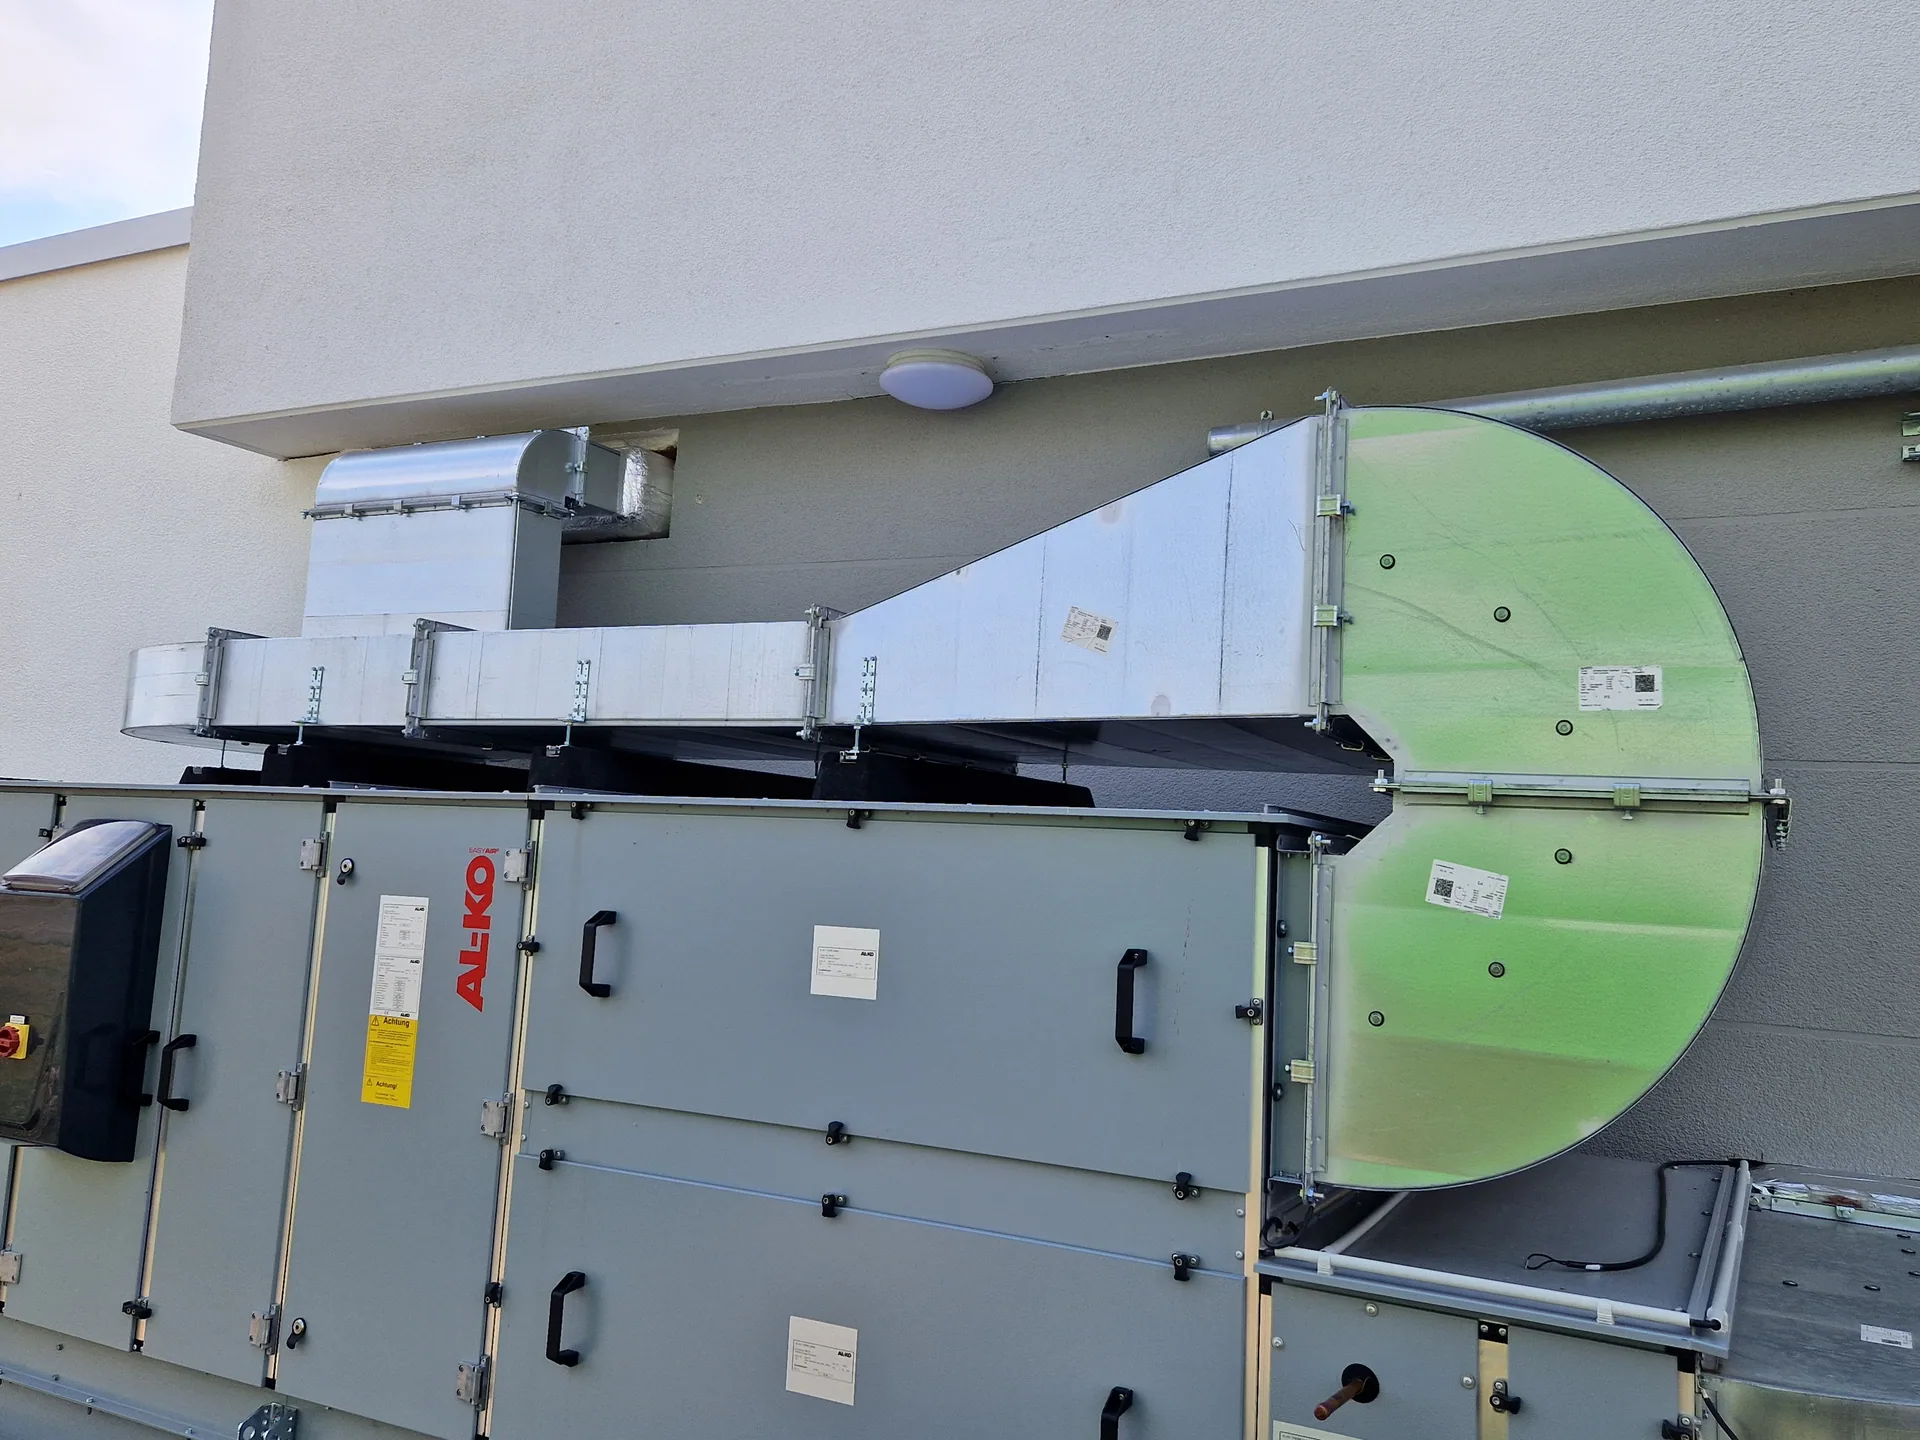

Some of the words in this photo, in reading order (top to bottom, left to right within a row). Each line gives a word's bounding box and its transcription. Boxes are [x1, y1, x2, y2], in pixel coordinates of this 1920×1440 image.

[456, 855, 496, 1013] AL-KO
[383, 1017, 410, 1028] Achtung
[376, 1081, 398, 1090] Achtung!
